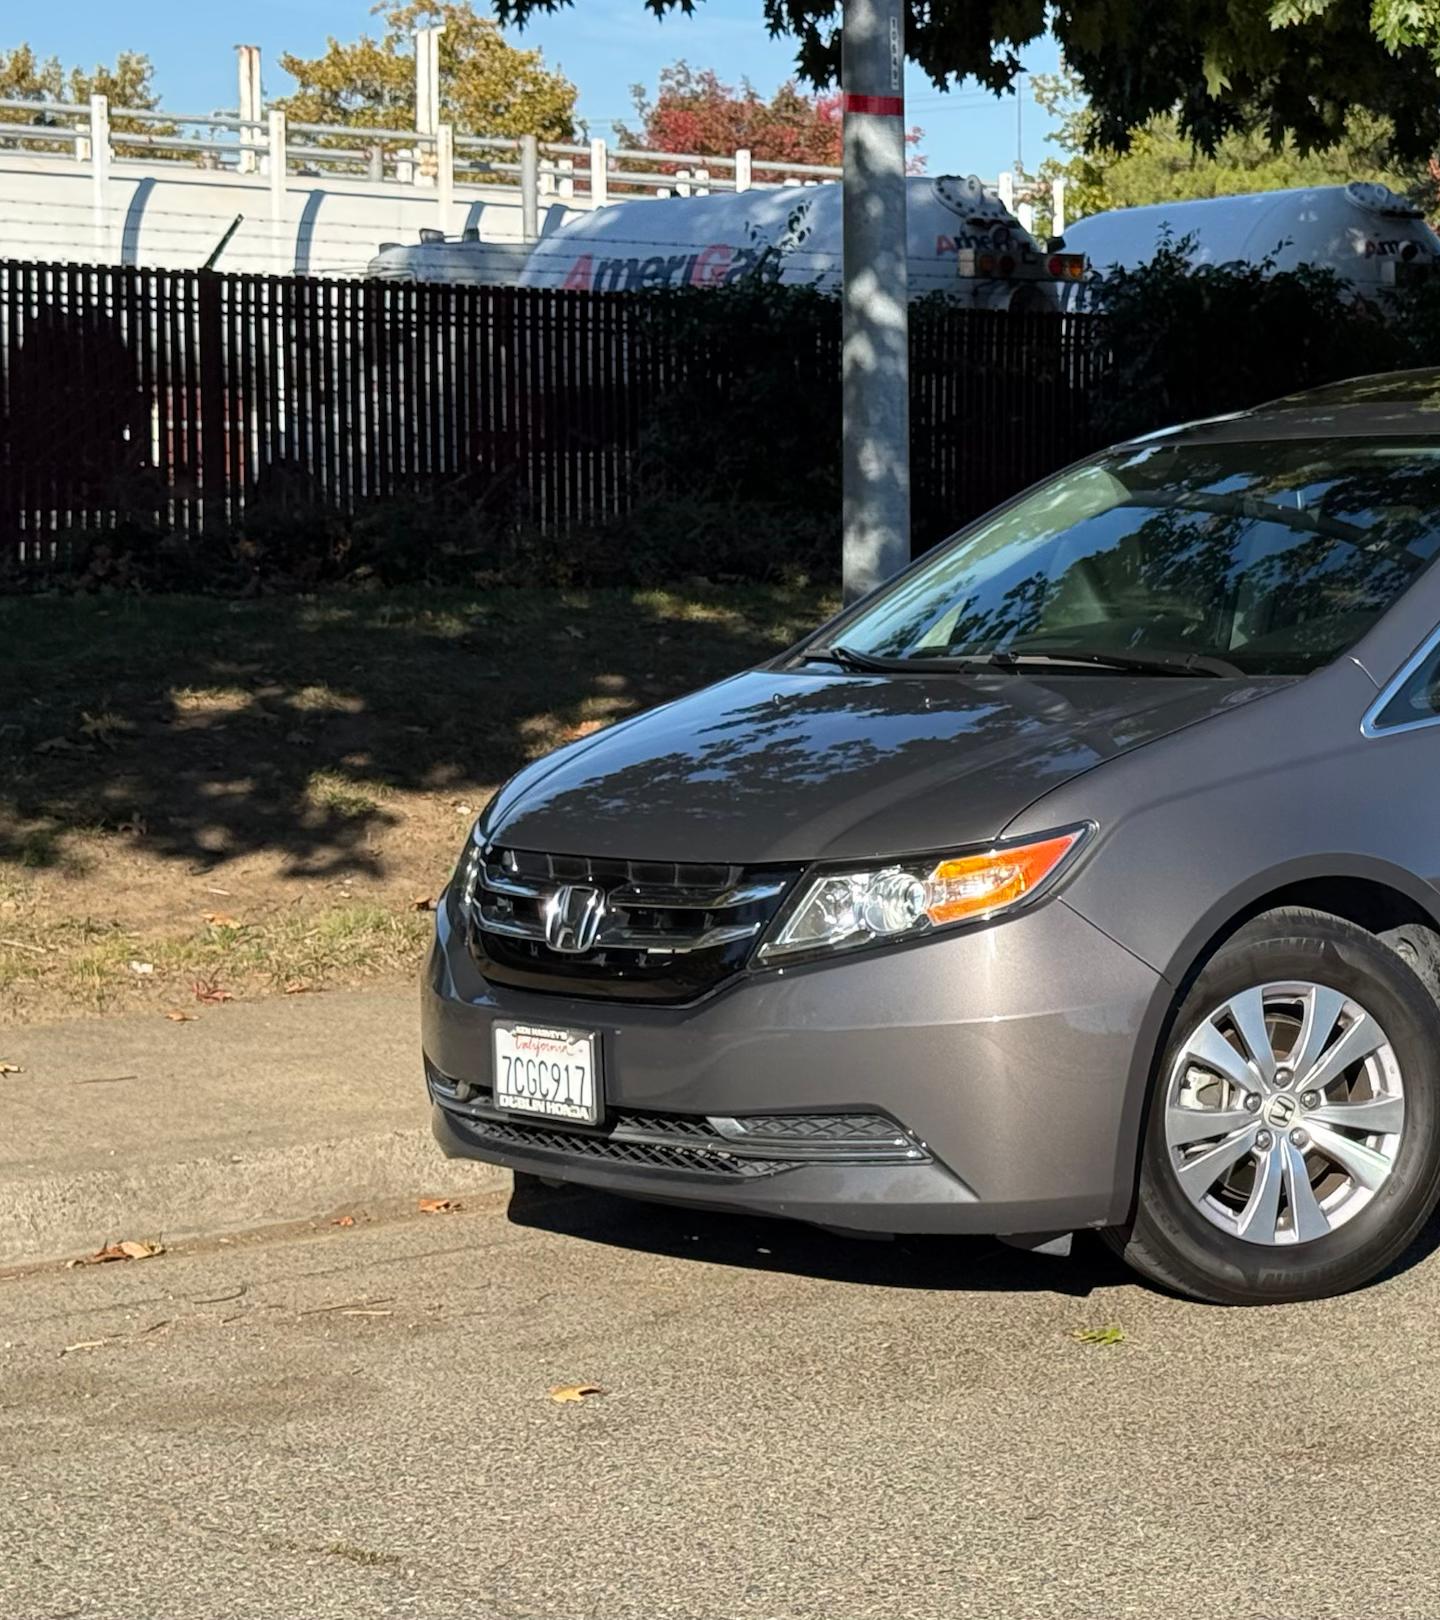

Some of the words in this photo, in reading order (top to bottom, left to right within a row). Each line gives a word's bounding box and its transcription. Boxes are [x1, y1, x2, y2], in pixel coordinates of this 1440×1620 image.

[562, 243, 784, 292] AmeriGa
[501, 1055, 585, 1106] 7CGC917
[499, 1094, 545, 1113] DUBLIN
[546, 1101, 590, 1121] HONDA
